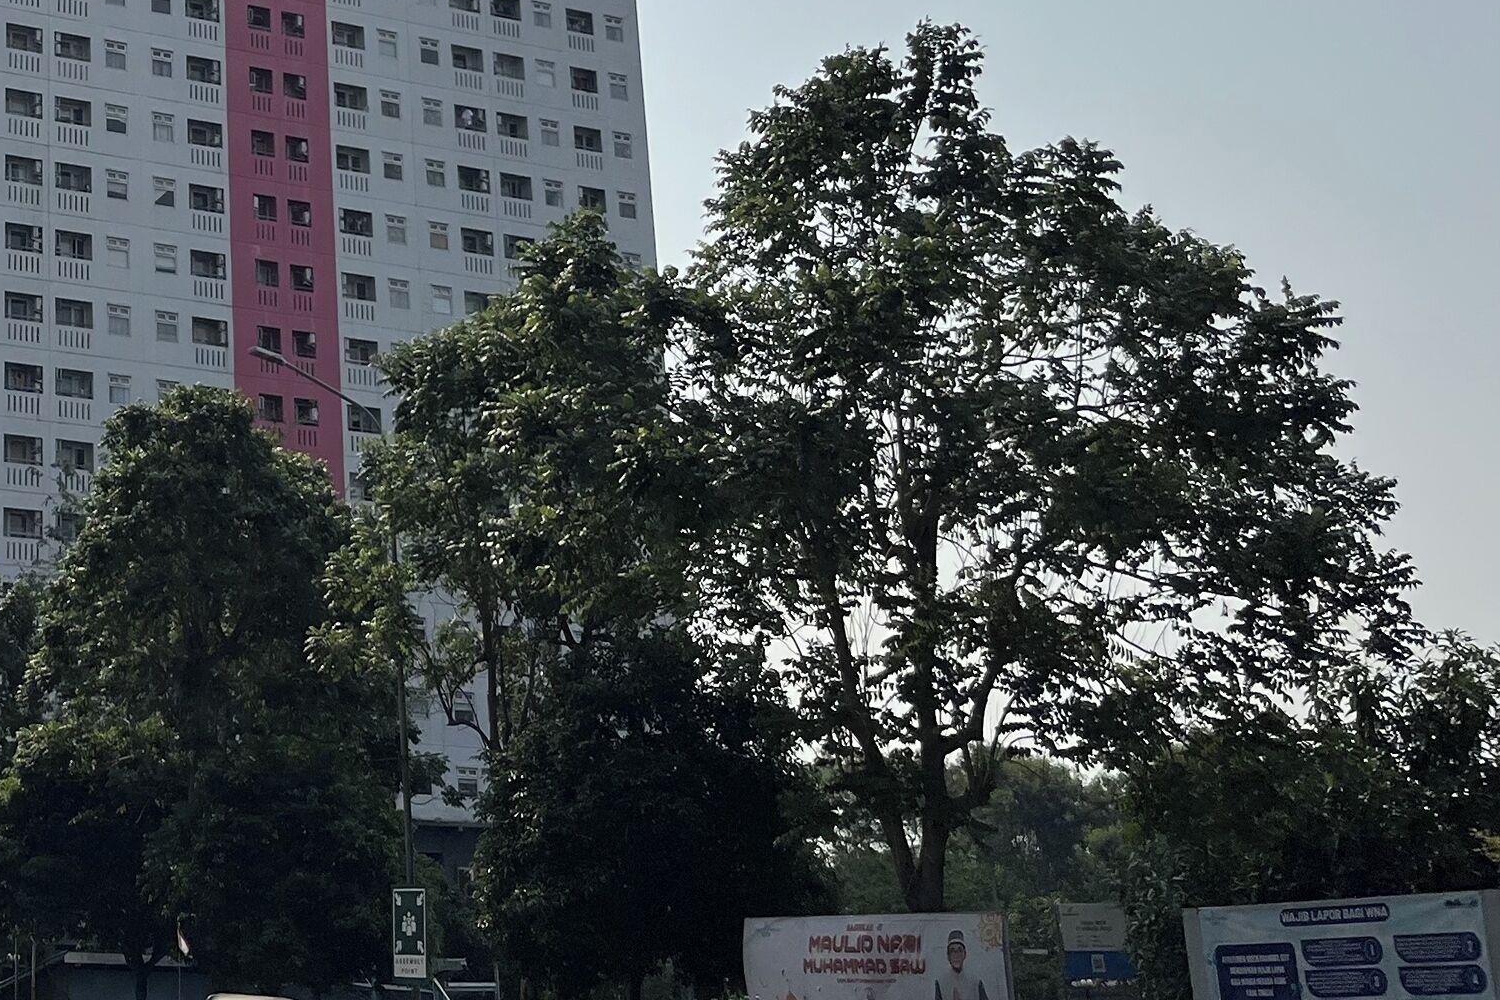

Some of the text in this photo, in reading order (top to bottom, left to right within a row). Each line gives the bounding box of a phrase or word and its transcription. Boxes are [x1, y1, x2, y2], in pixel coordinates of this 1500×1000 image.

[1281, 906, 1389, 923] WAJIB LAPOR BAGI WNA
[809, 933, 922, 954] MAULID NABI
[803, 957, 926, 975] MUHAMMAD SAW
